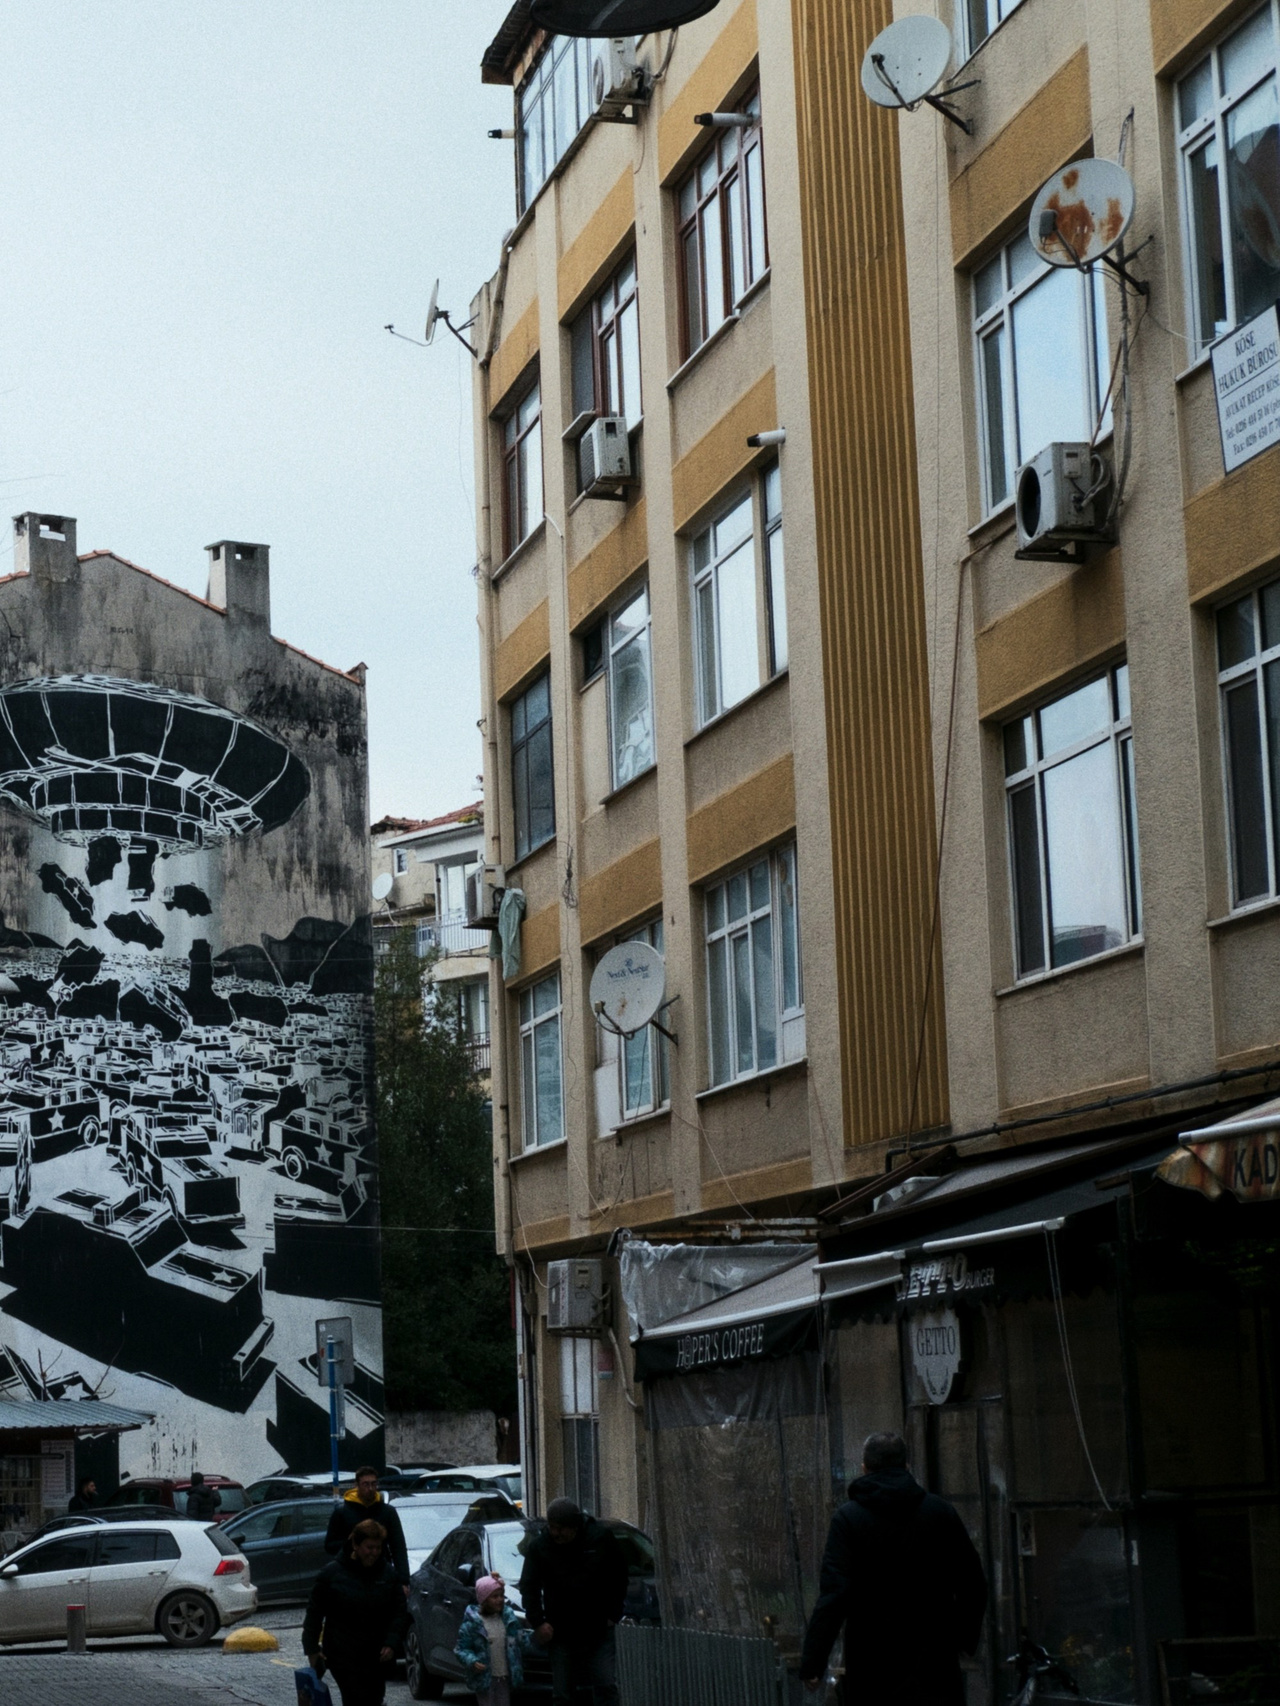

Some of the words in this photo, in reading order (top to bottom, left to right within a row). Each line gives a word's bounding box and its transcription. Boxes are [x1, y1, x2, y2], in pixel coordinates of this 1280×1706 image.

[1235, 331, 1255, 357] KÖSE
[1218, 362, 1246, 393] HUKUK
[1247, 340, 1279, 374] BÜROSU
[1233, 1143, 1280, 1188] KAD
[965, 1267, 995, 1290] BURGER
[721, 1323, 765, 1361] COFFEE
[916, 1325, 956, 1357] GETTO
